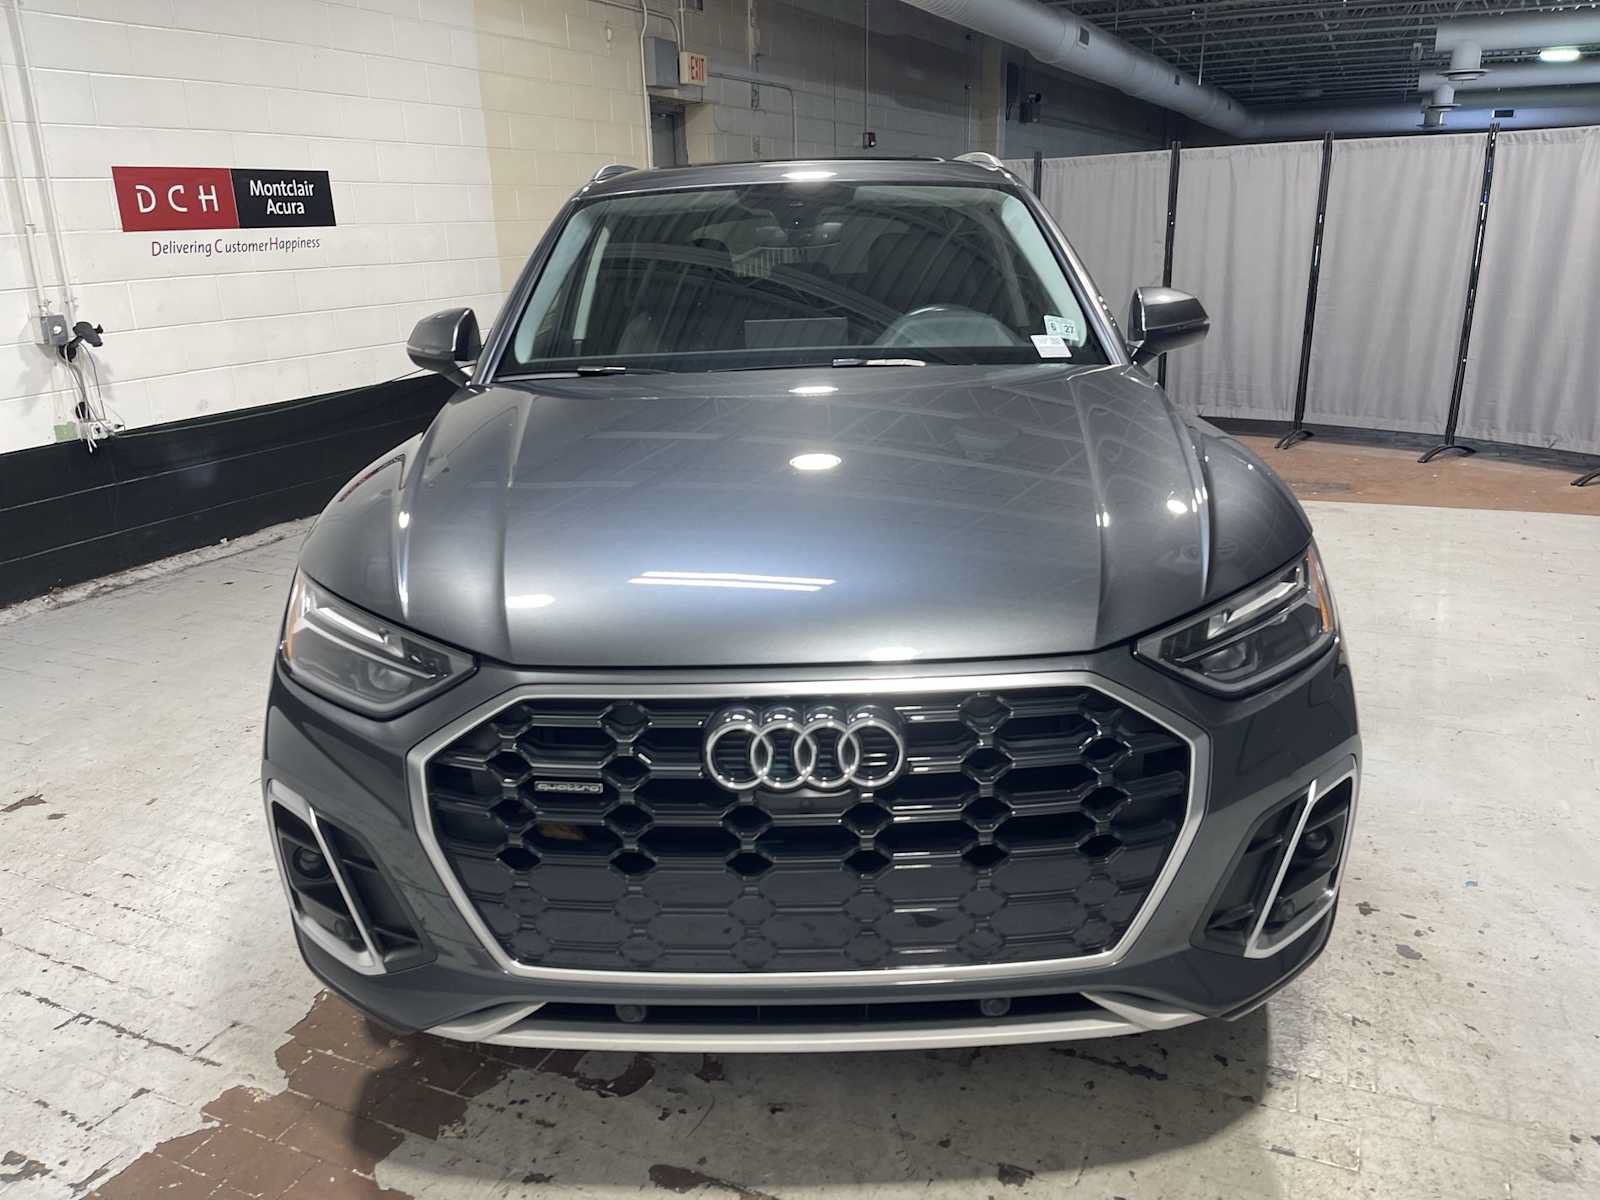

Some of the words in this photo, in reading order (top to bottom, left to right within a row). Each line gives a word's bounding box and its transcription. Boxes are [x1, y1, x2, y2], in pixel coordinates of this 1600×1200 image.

[690, 55, 704, 80] EXIT
[250, 180, 315, 197] Montclair
[266, 199, 305, 215] Acura
[151, 240, 212, 257] Delivering
